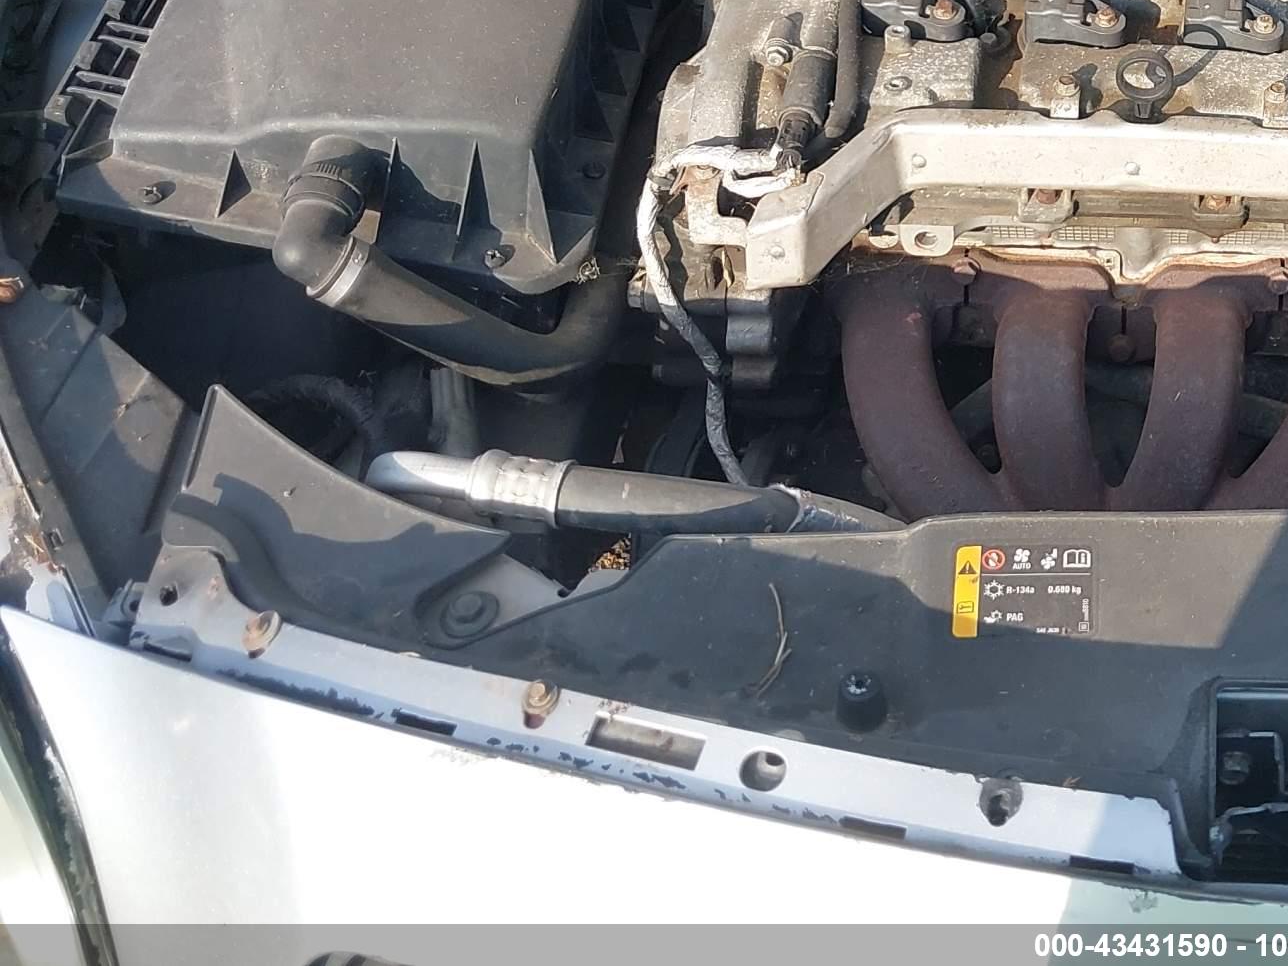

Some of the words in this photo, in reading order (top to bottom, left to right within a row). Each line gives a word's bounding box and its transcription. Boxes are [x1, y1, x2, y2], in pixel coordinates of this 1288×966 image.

[1012, 562, 1032, 570] AUTO
[1006, 585, 1035, 594] R-134a
[1071, 585, 1082, 596] kg
[1006, 612, 1024, 622] PAG
